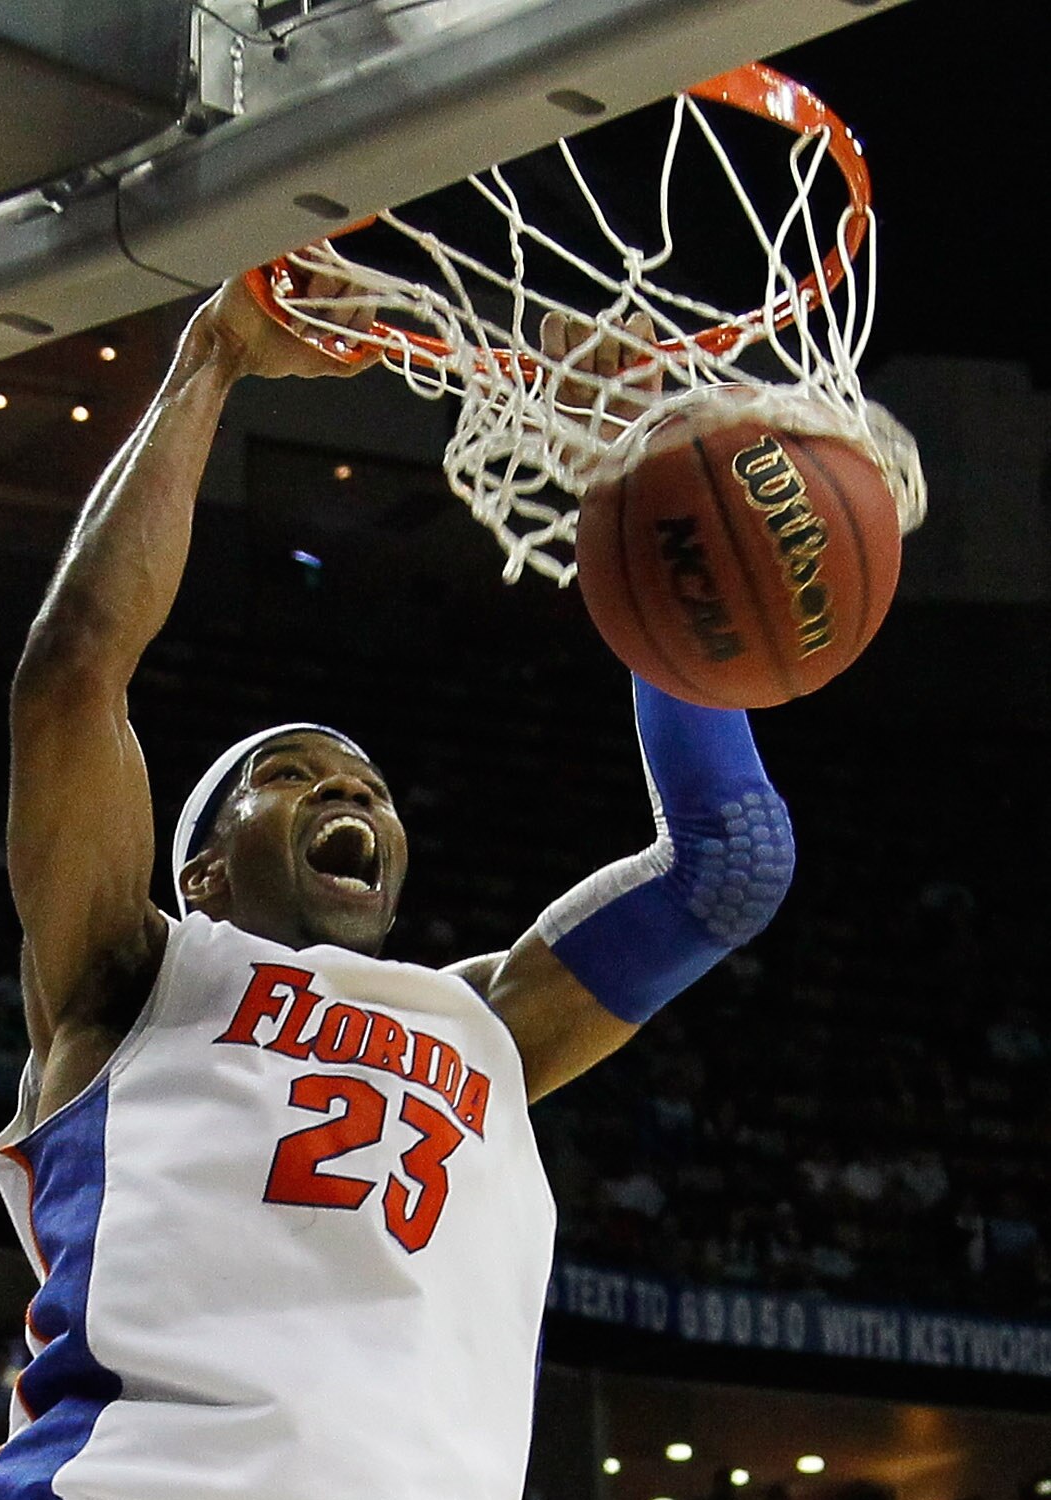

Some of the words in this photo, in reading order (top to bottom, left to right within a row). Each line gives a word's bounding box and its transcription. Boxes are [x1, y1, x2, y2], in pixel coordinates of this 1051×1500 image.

[655, 517, 746, 662] NCAA
[732, 434, 837, 660] Wilson
[212, 962, 490, 1143] FLORIDA
[262, 1073, 465, 1254] 23
[563, 1263, 628, 1325] TEXT
[632, 1277, 669, 1333] TO
[818, 1303, 902, 1360] WITH
